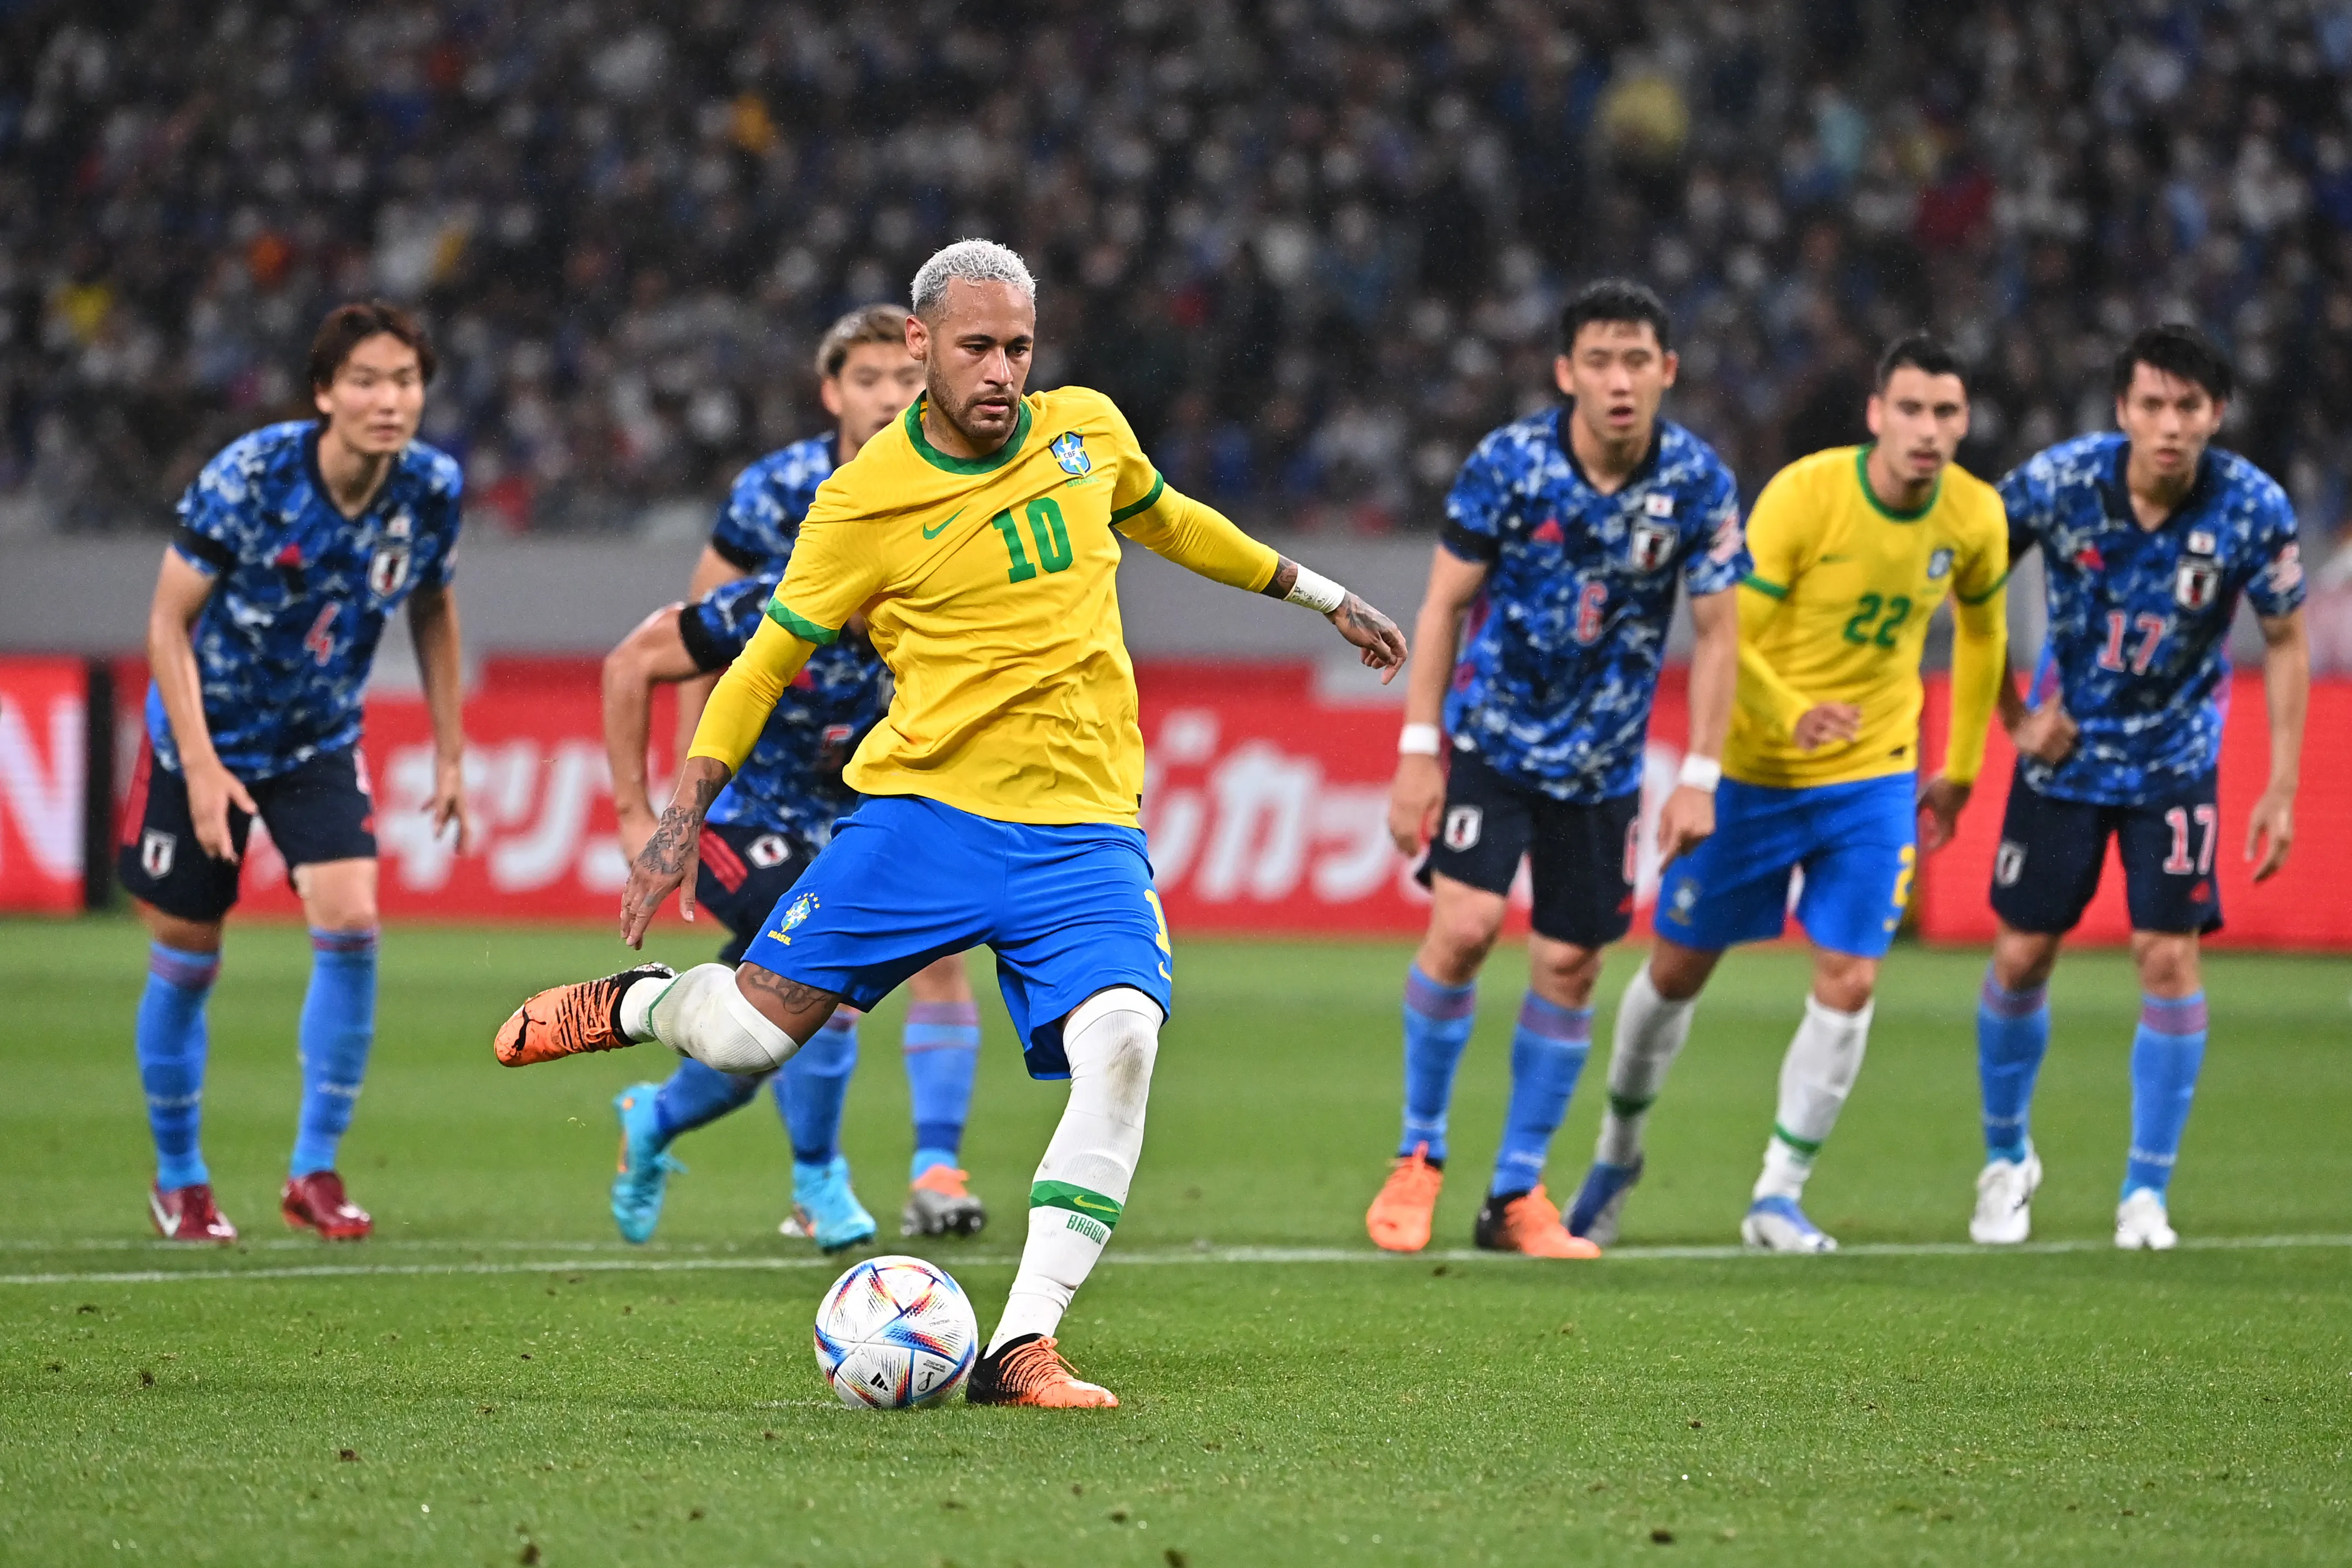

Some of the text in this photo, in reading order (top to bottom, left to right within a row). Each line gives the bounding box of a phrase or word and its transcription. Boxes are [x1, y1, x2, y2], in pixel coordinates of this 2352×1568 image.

[1063, 450, 1076, 459] CBF
[991, 497, 1074, 584] 10
[305, 601, 341, 666] 4
[1576, 580, 1608, 645] 6
[1843, 592, 1912, 651] 22
[2097, 610, 2165, 676] 17
[2162, 804, 2217, 875] 17
[767, 930, 792, 946] BRASIL
[1066, 1214, 1106, 1245] BRASIL
